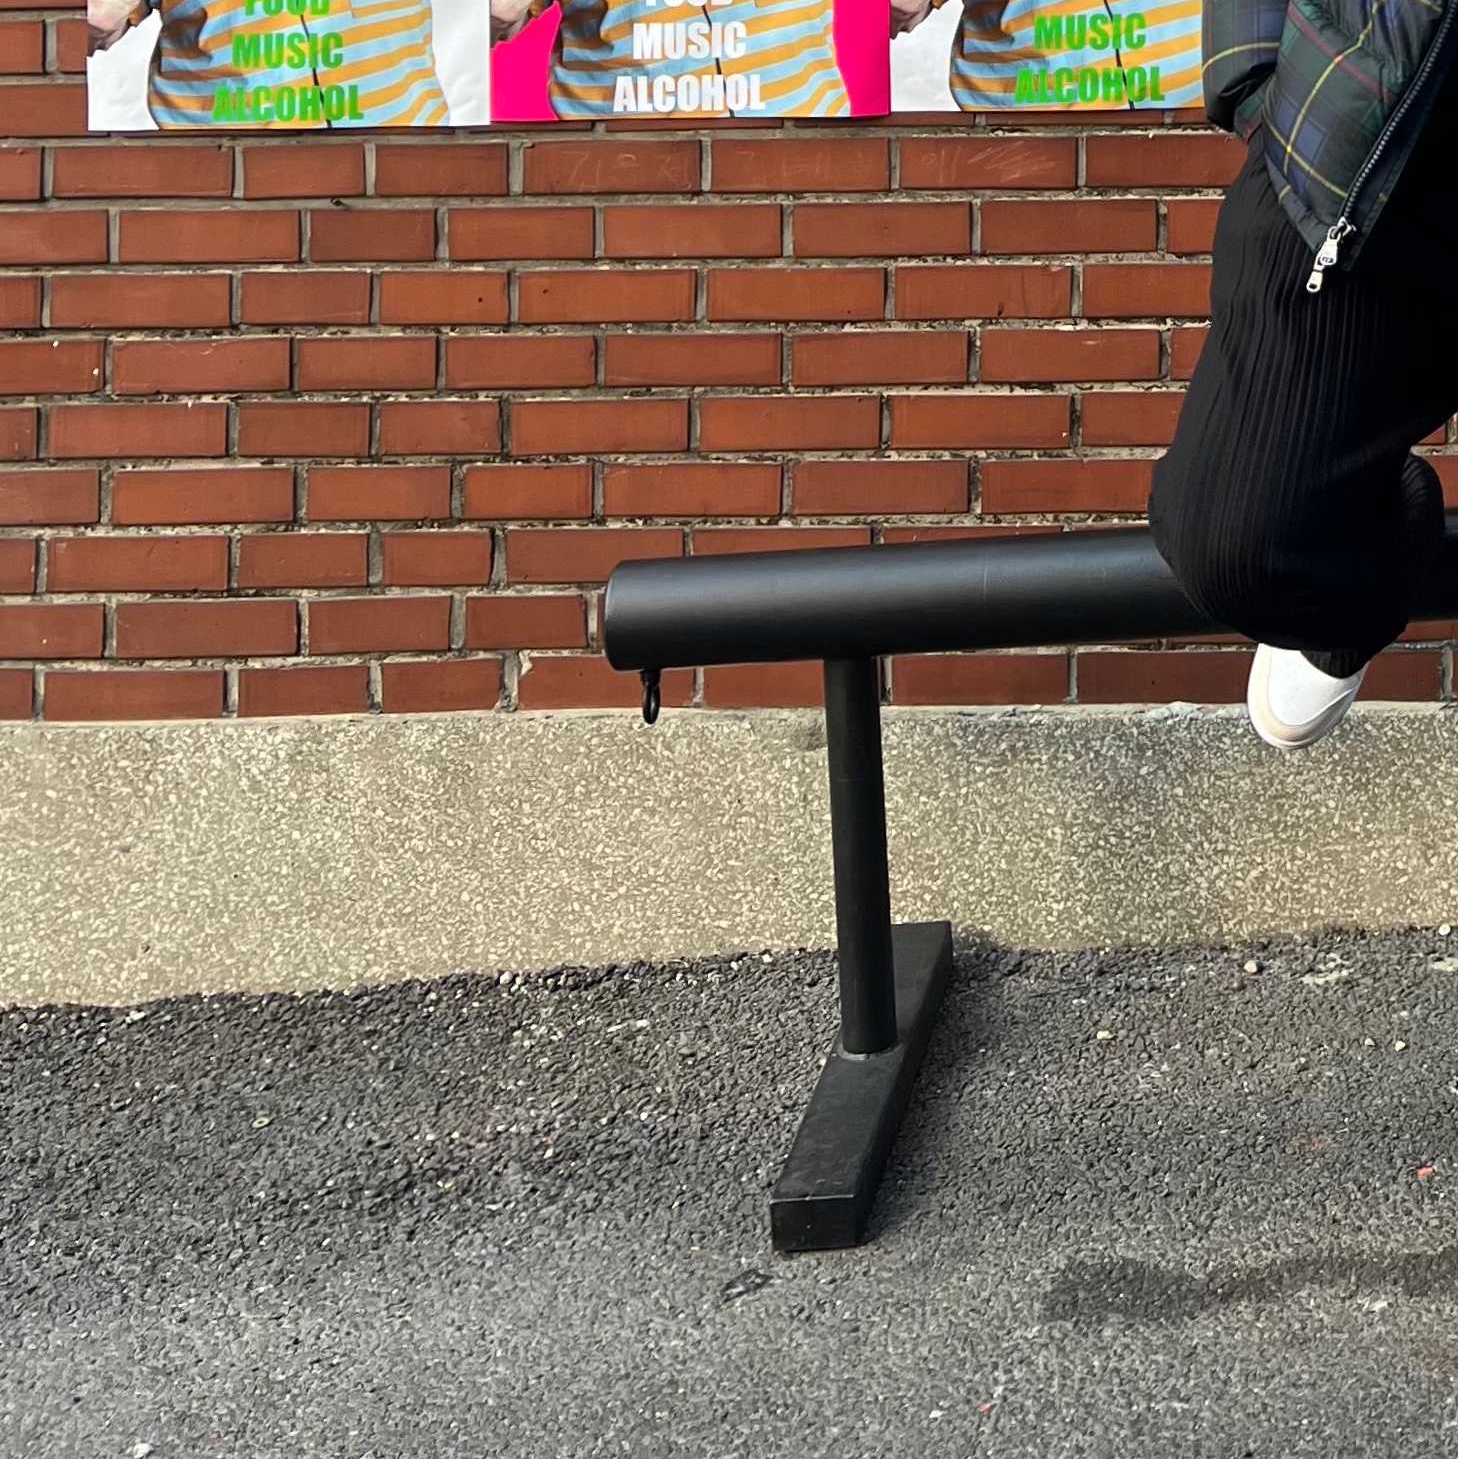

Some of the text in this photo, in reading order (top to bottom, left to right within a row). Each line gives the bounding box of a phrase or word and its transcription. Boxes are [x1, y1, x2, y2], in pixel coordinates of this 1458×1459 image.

[232, 30, 344, 69] MUSIC
[632, 20, 746, 58] MUSIC
[1034, 12, 1147, 49] MUSIC
[211, 83, 364, 121] ALCOHOL
[613, 72, 766, 111] ALCOHOL
[1014, 64, 1165, 102] ALCOHOL
